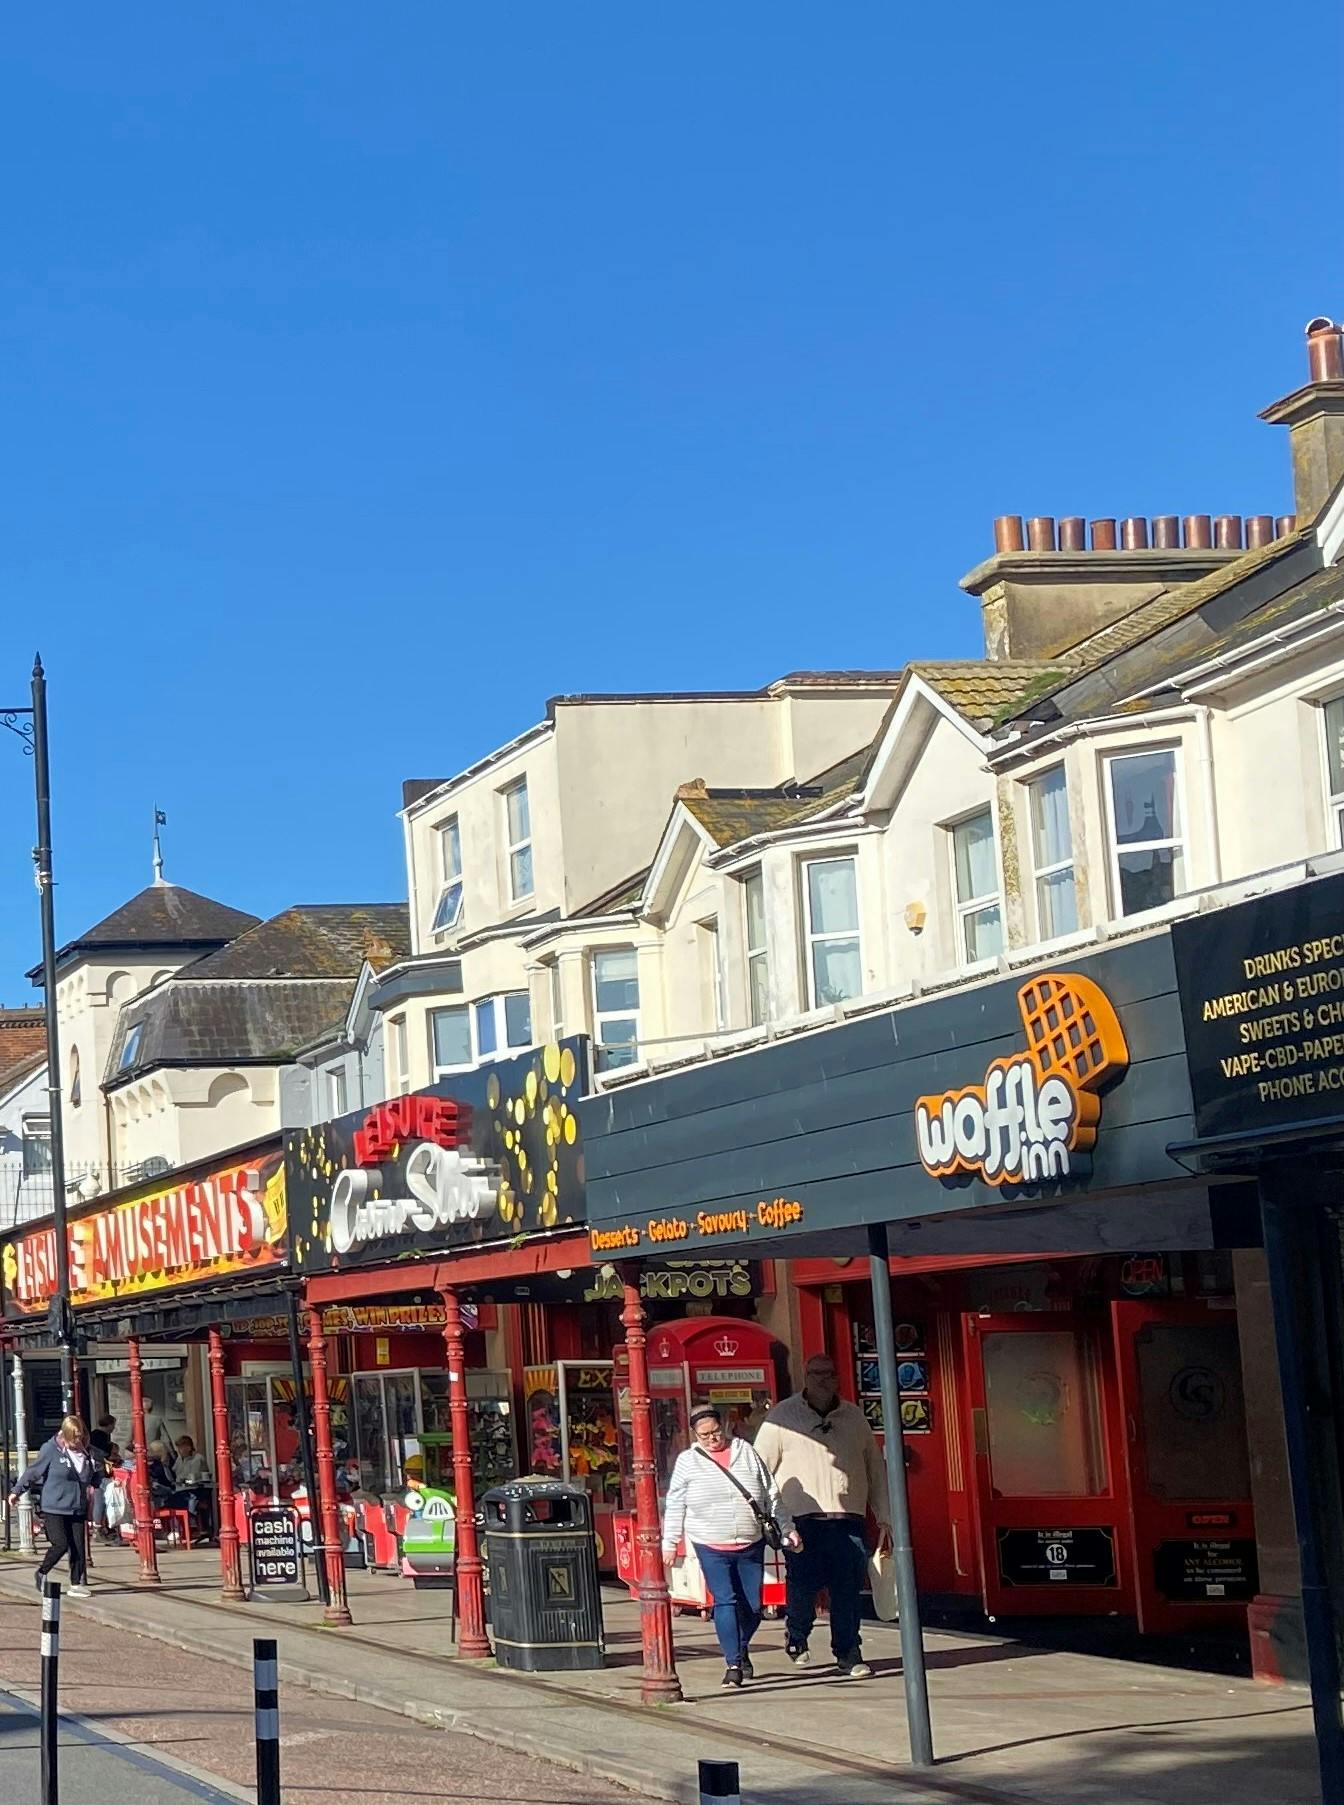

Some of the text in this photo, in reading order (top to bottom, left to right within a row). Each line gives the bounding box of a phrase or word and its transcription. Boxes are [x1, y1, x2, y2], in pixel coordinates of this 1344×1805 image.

[1243, 933, 1344, 979] DRINKS SPEC
[1202, 983, 1281, 1021] AMERICAN
[1283, 981, 1295, 1001] &
[1240, 1012, 1301, 1043] SWEETS
[1303, 1008, 1315, 1030] &
[1258, 1073, 1316, 1102] PHONE
[916, 1061, 1074, 1175] waffle
[1021, 1133, 1070, 1182] inn
[92, 1170, 260, 1285] AMUSEMENTS
[591, 1197, 801, 1250] Desserts Gelato Savoury Coffee
[698, 1370, 763, 1383] TELEPHONE
[255, 1516, 294, 1534] cash
[255, 1535, 294, 1546] machine
[256, 1559, 296, 1576] here
[1049, 1546, 1065, 1562] 18
